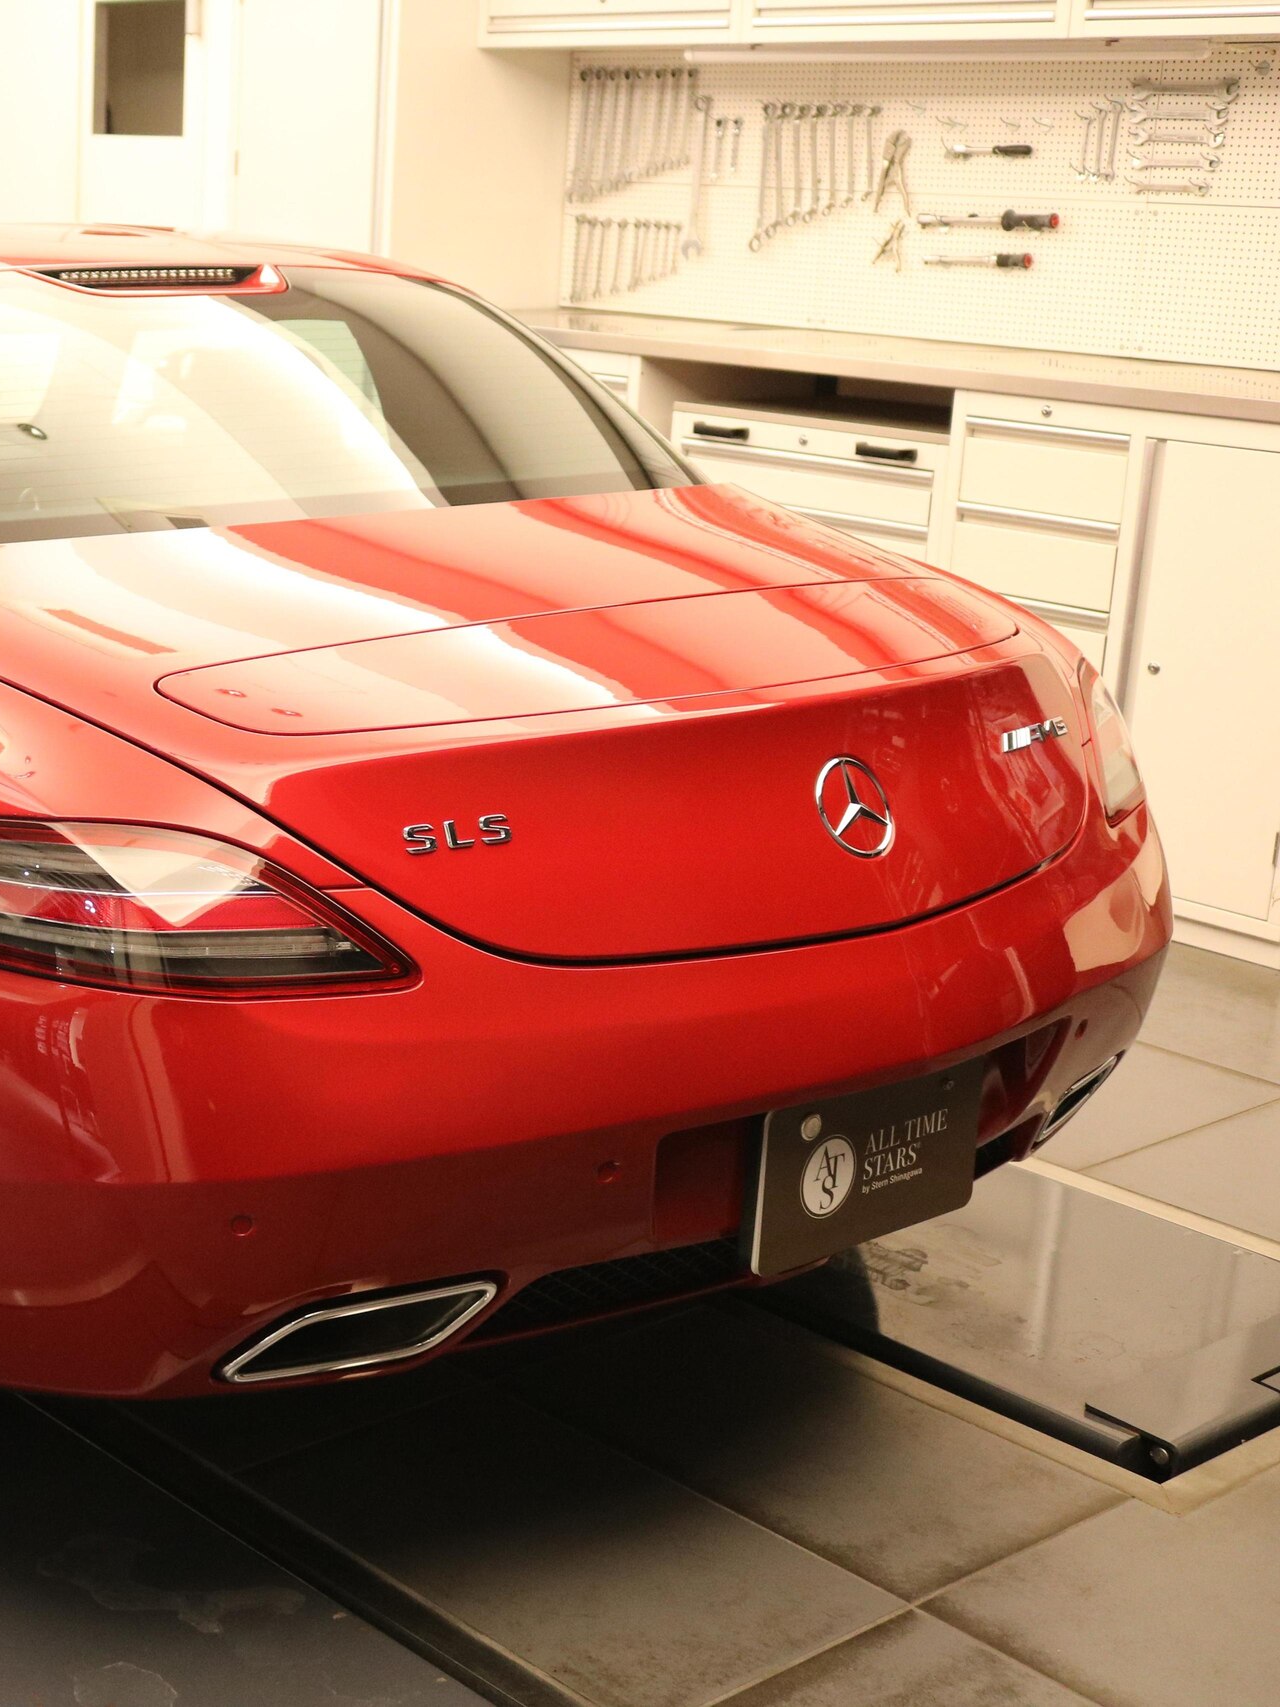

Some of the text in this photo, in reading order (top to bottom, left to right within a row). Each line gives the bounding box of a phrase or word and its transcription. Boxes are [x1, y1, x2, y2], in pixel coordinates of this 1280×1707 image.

[402, 813, 513, 855] SLS
[865, 1108, 949, 1155] ALL TIME
[861, 1167, 923, 1195] by Stern Shinagawa
